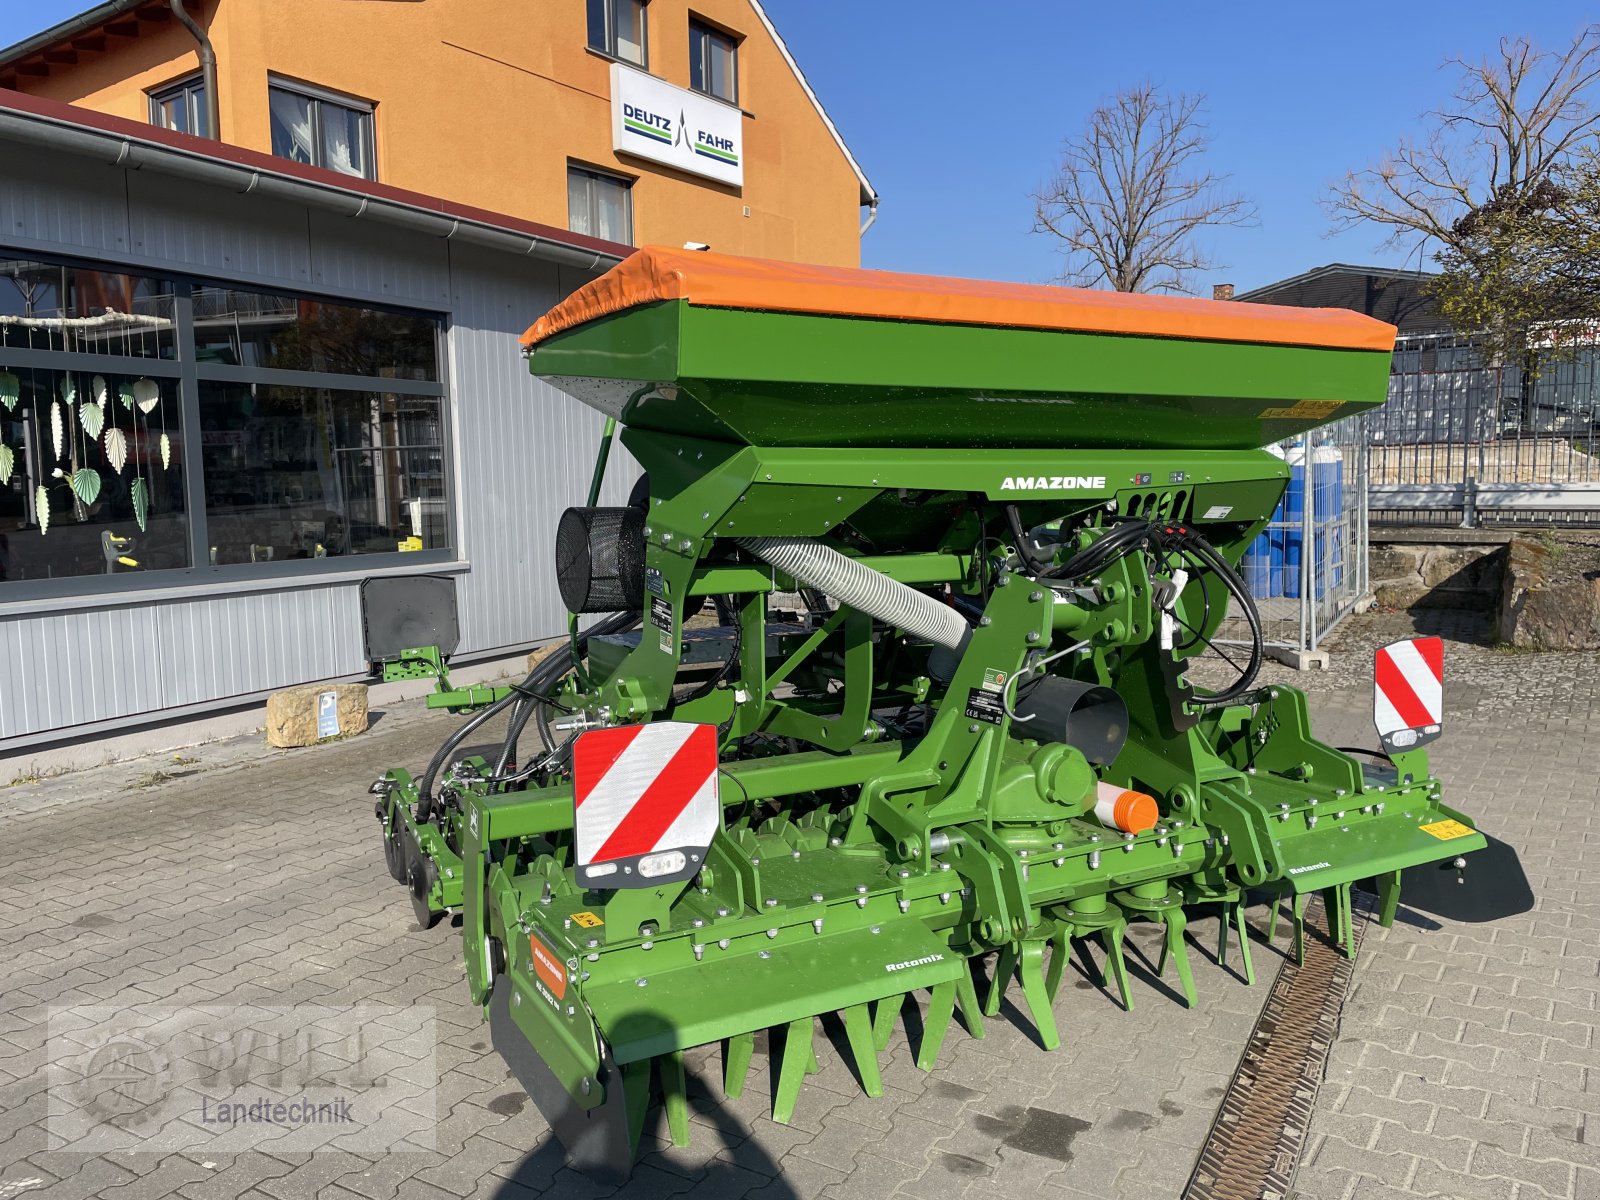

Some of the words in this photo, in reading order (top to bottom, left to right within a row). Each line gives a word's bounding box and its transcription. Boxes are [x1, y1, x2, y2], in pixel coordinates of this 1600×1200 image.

[624, 103, 671, 131] DEUTZ
[698, 130, 733, 152] FAHR
[1001, 477, 1106, 489] AMAZONE
[321, 696, 331, 716] P
[1288, 861, 1332, 875] Rotamix
[885, 953, 945, 972] Rotamix
